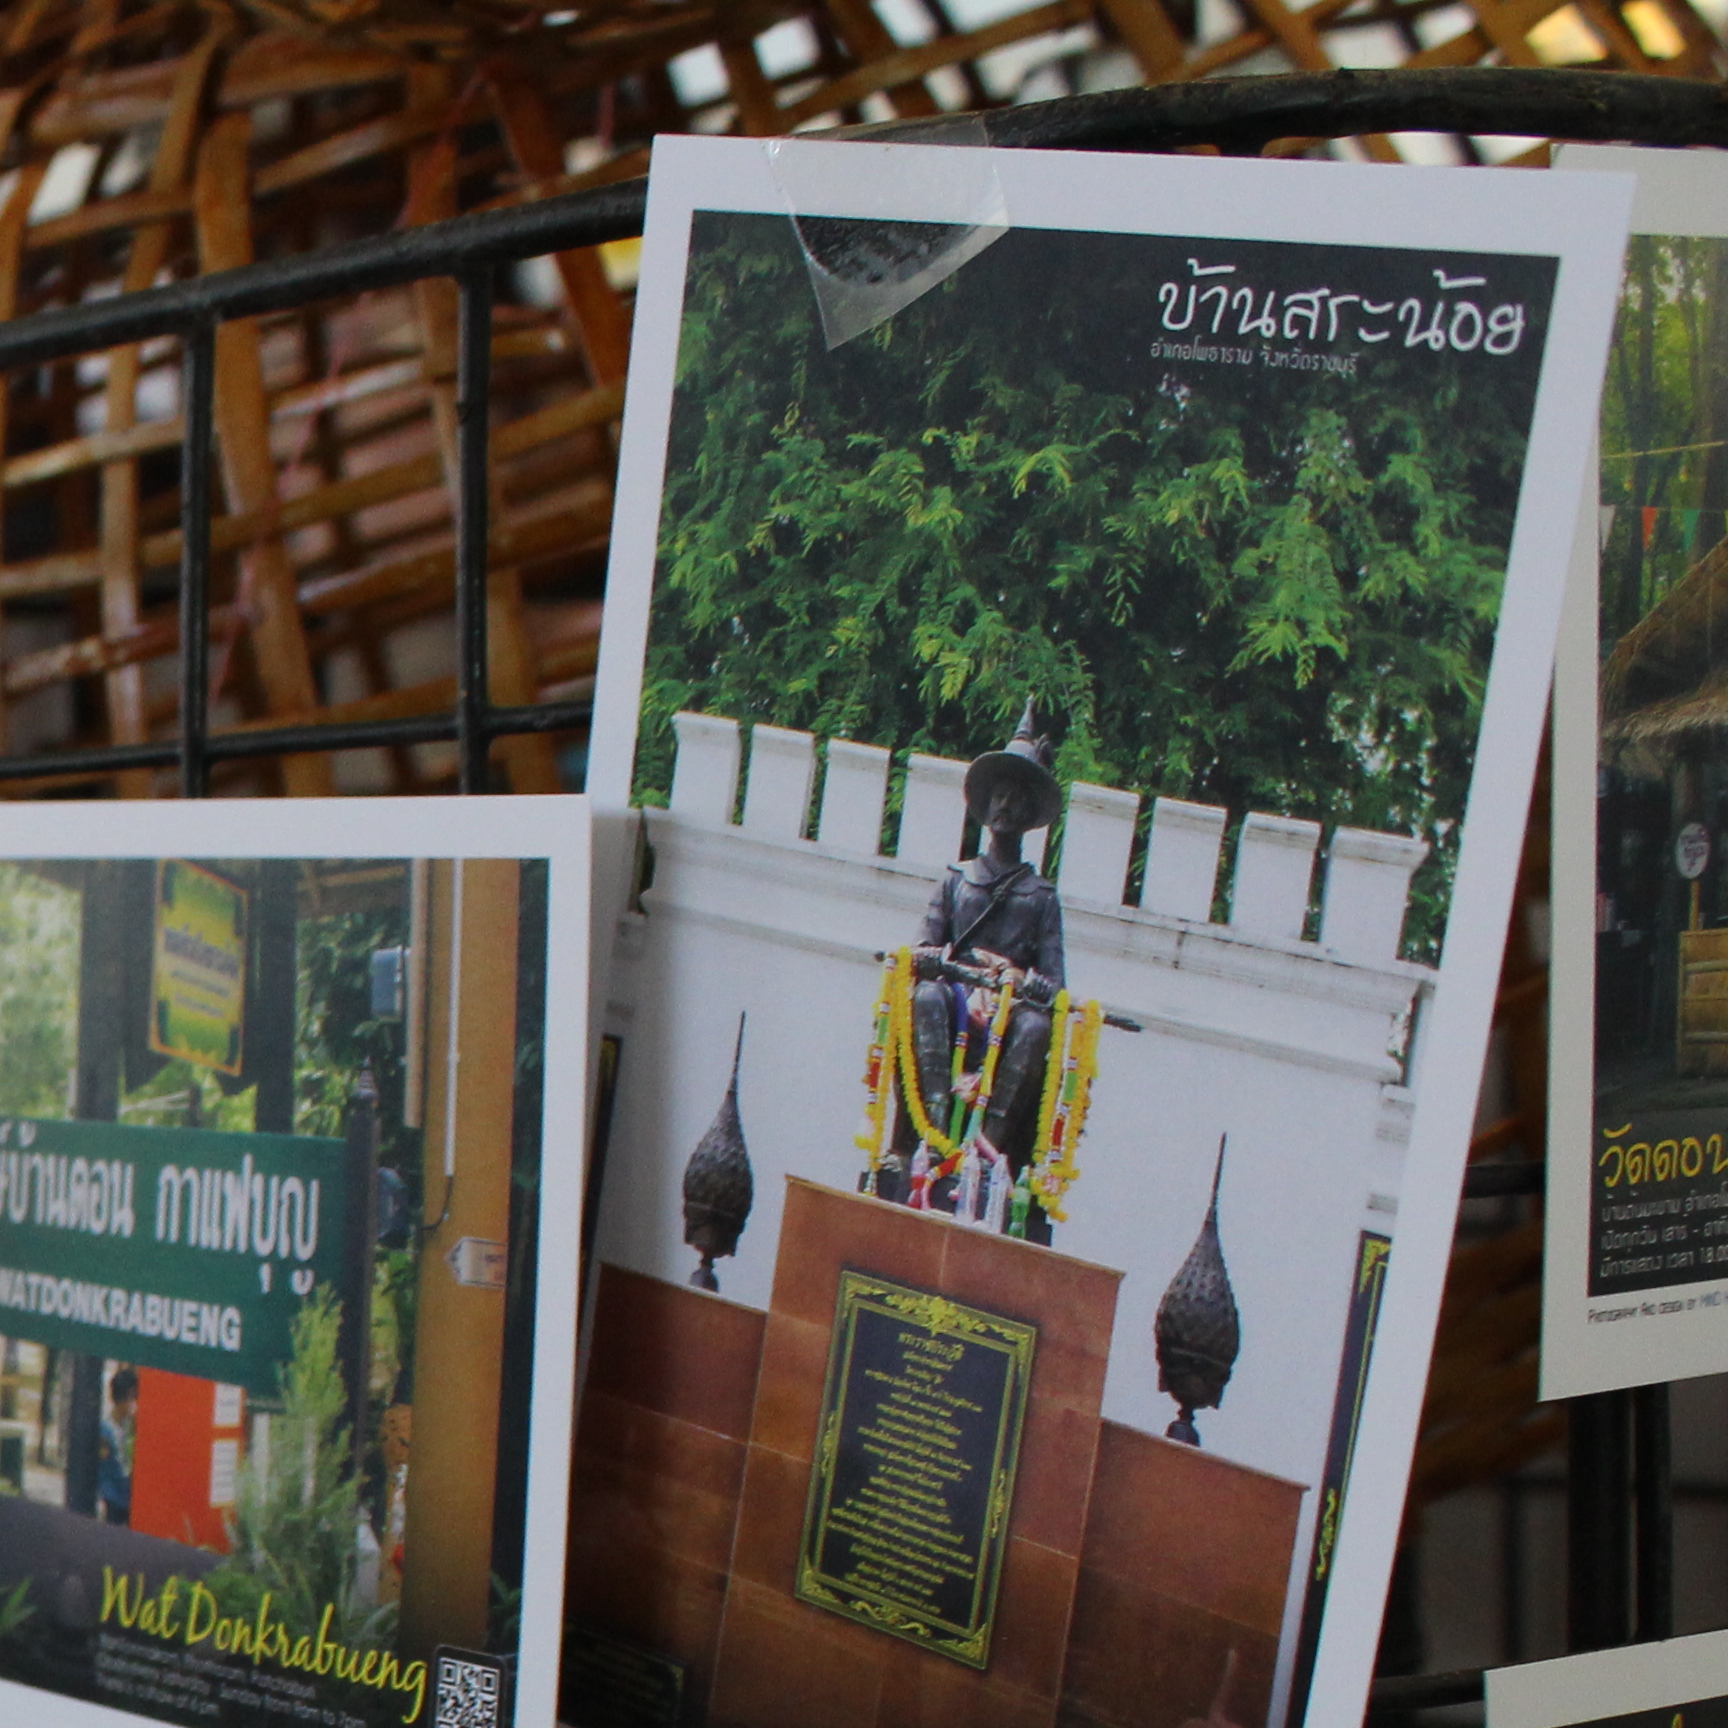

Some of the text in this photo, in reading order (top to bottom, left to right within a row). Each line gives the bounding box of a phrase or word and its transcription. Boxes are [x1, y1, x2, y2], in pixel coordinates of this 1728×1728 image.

[1158, 258, 1527, 355] บ้านสระน้อย
[155, 1152, 321, 1296] กาแฟบุญ
[100, 1566, 180, 1639] Wat
[185, 1580, 429, 1724] Donkrabueng
